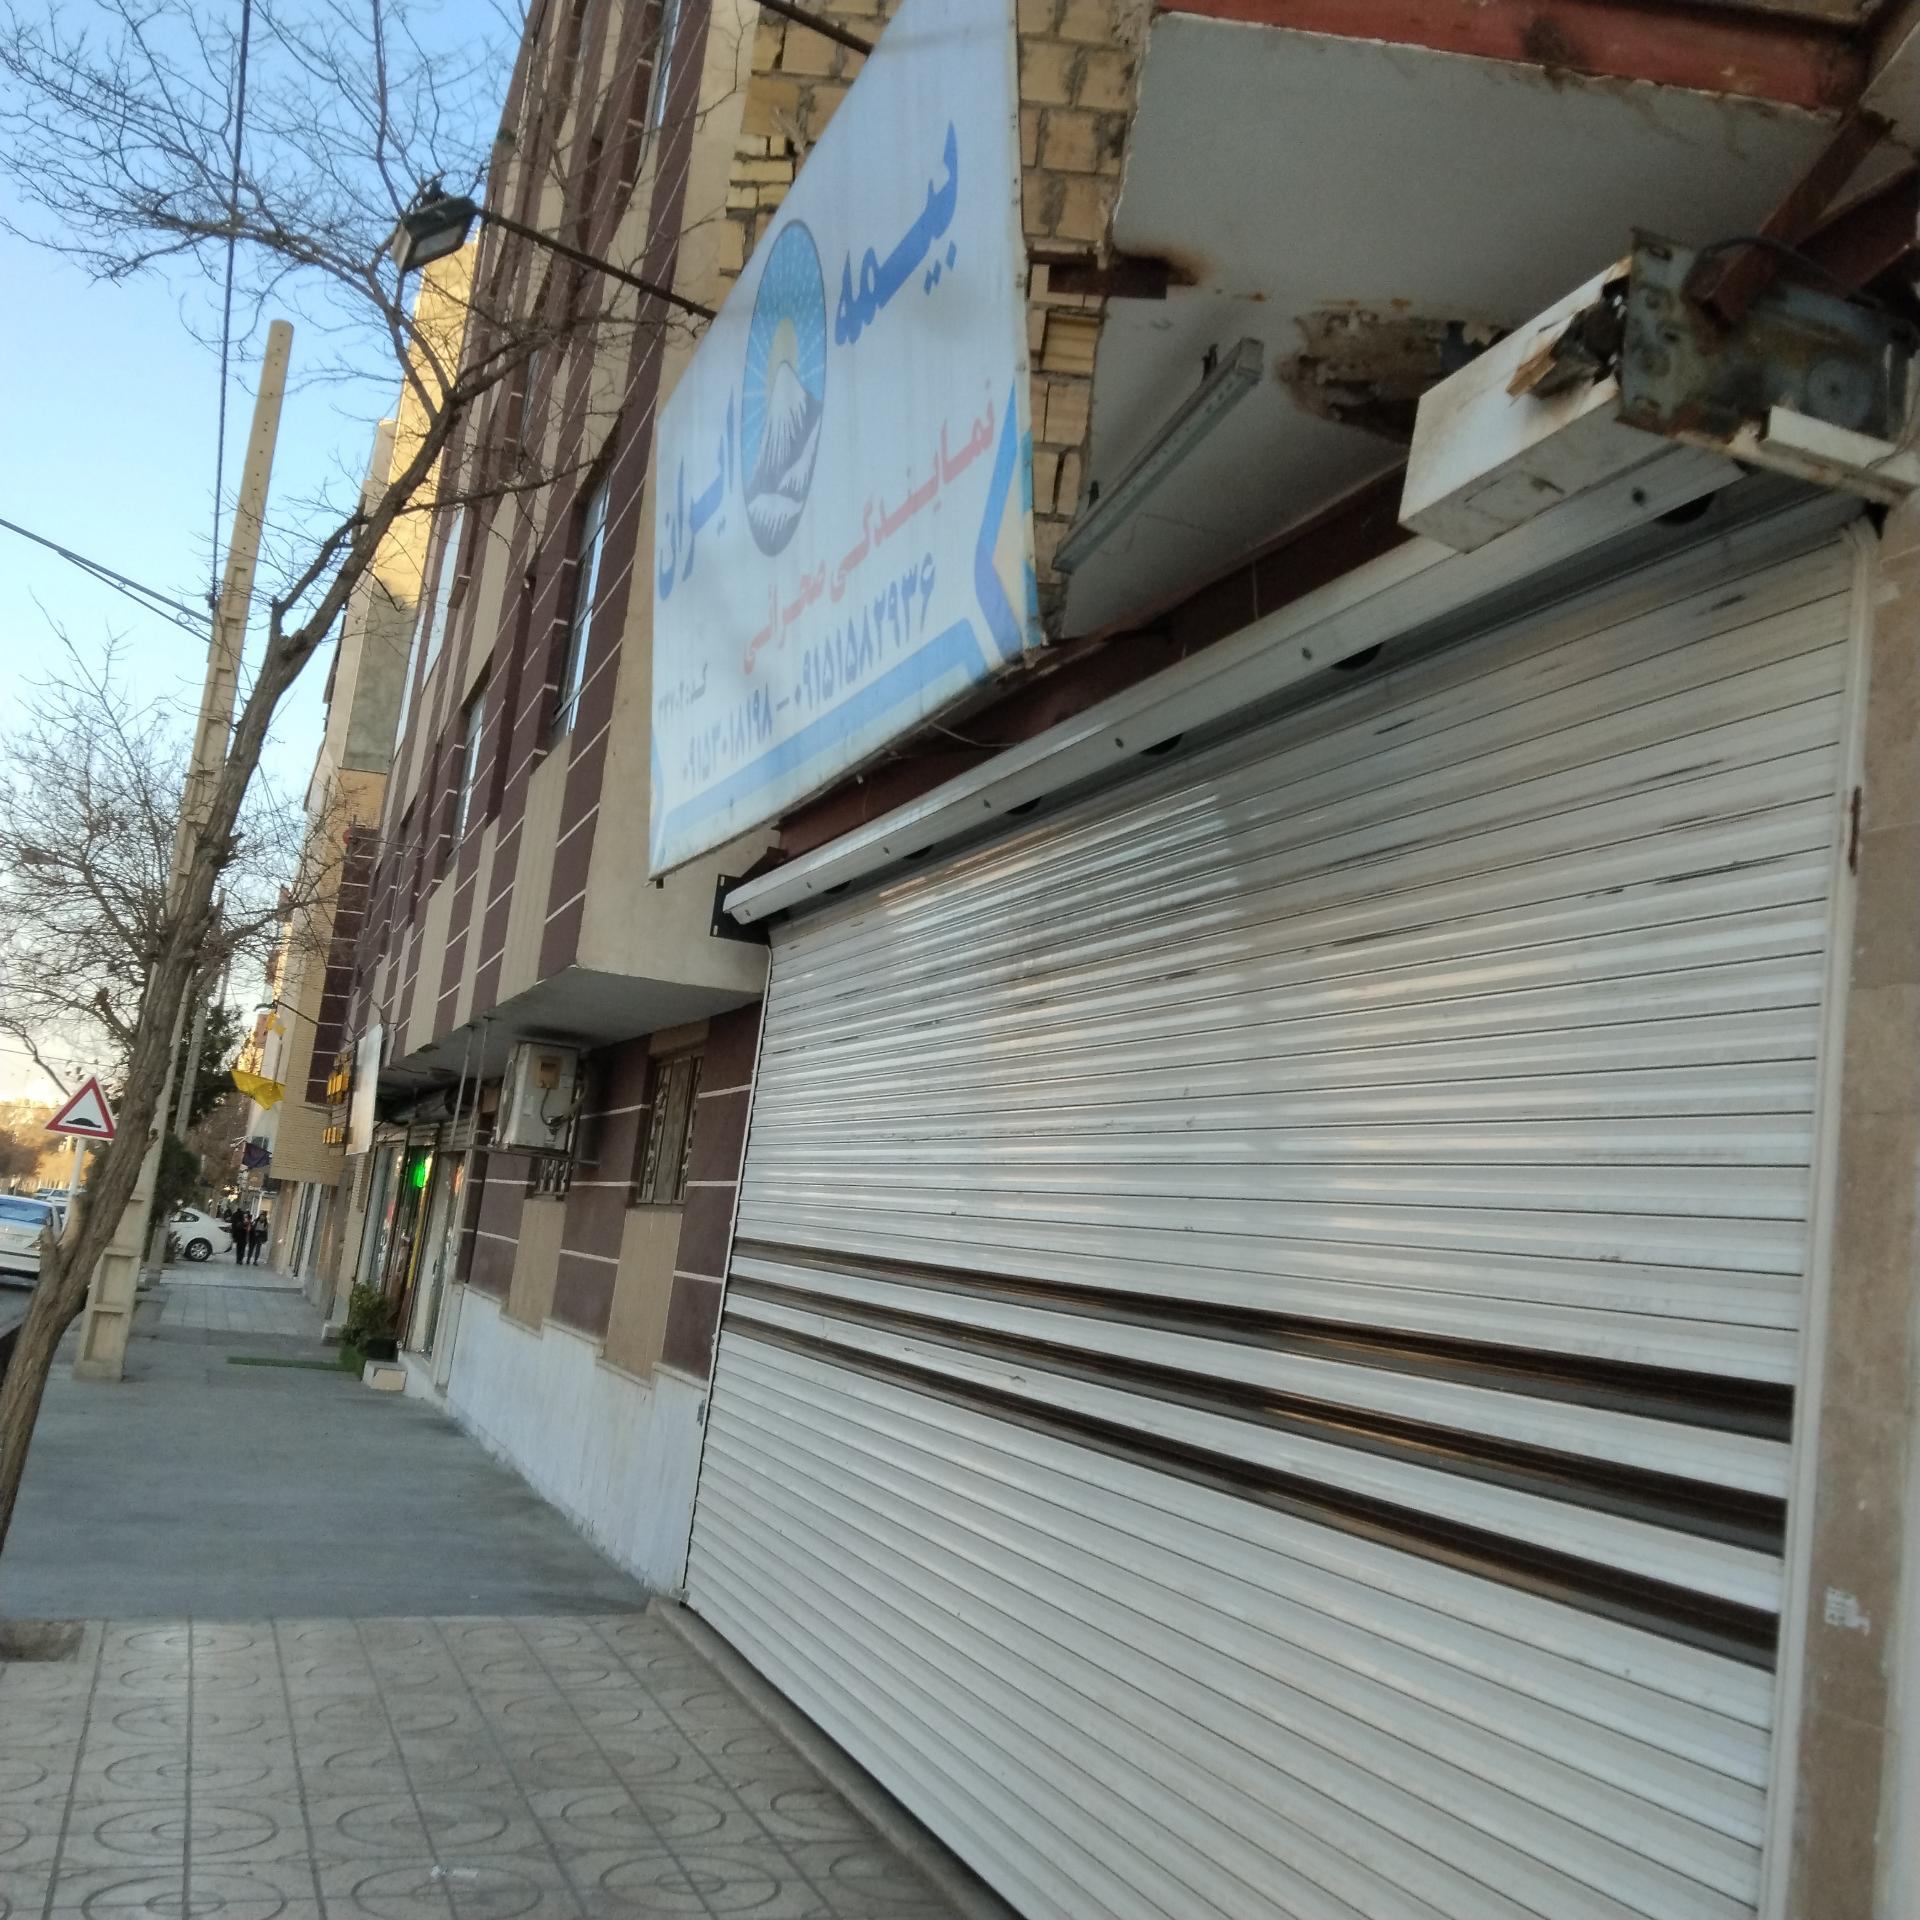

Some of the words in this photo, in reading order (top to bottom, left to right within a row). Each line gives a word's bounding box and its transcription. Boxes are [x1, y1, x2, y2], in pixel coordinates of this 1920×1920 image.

[834, 119, 958, 347] بیمه
[658, 388, 735, 601] ایران
[830, 377, 995, 603] نمایندگی
